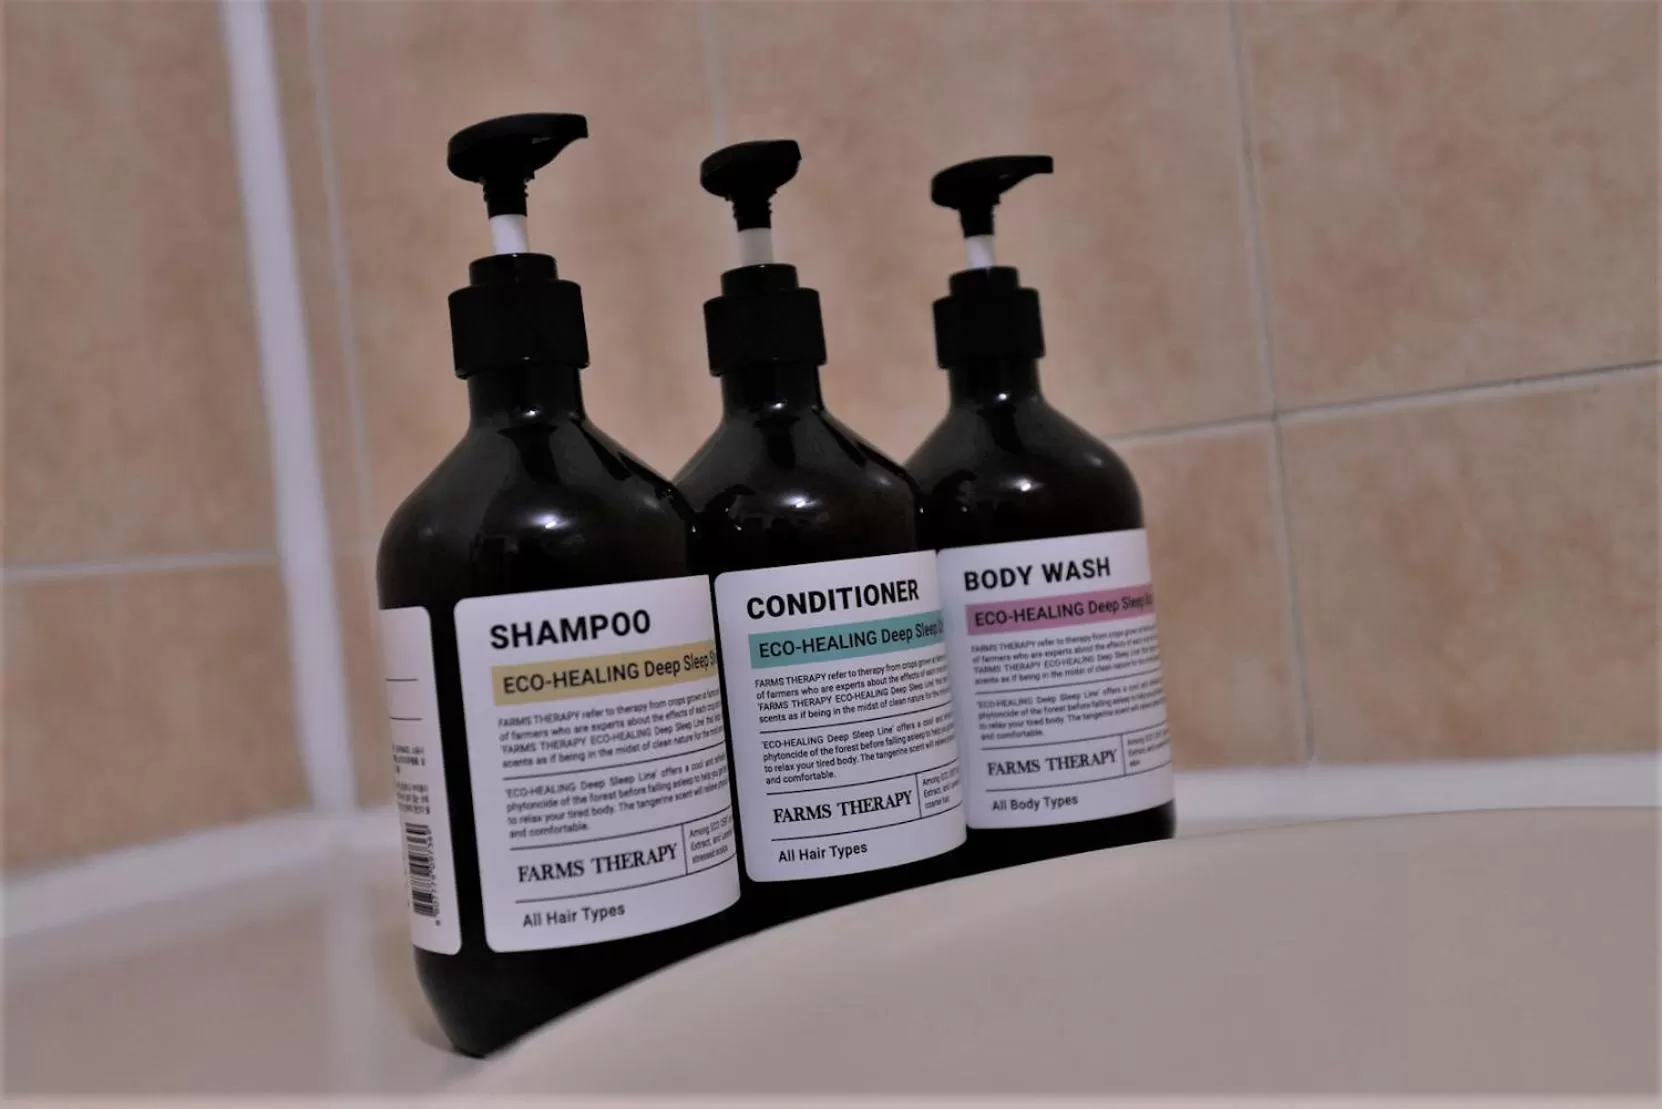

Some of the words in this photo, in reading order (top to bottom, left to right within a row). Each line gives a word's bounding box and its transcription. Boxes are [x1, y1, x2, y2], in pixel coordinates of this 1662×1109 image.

[964, 565, 1032, 592] BODY
[1041, 557, 1110, 583] WASH
[747, 579, 918, 619] CONDITIONER
[974, 602, 1084, 627] ECO-HEALING
[1088, 600, 1120, 615] Deep
[491, 610, 650, 649] SHAMPOO
[759, 630, 877, 658] ECO-HEALING
[881, 628, 913, 644] Deep
[915, 622, 939, 638] Sleep
[503, 662, 639, 694] ECO-HEALING
[644, 660, 681, 678] Deep
[683, 653, 709, 671] Sleep
[785, 673, 826, 685] THERAPY
[800, 686, 819, 695] who
[987, 759, 1041, 776] FARMS
[1045, 750, 1116, 771] THERAPY
[765, 775, 782, 785] and
[773, 804, 832, 823] FARMS
[837, 790, 912, 816] THERAPY
[992, 800, 1007, 811] All
[1010, 798, 1040, 812] Body
[1043, 796, 1079, 810] Types
[518, 860, 585, 882] FARMS
[591, 843, 677, 874] THERAPY
[778, 849, 795, 863] All
[798, 847, 826, 861] Hair
[829, 843, 868, 860] Types
[523, 912, 542, 927] All
[546, 910, 577, 925] Hair
[581, 904, 625, 923] Types
